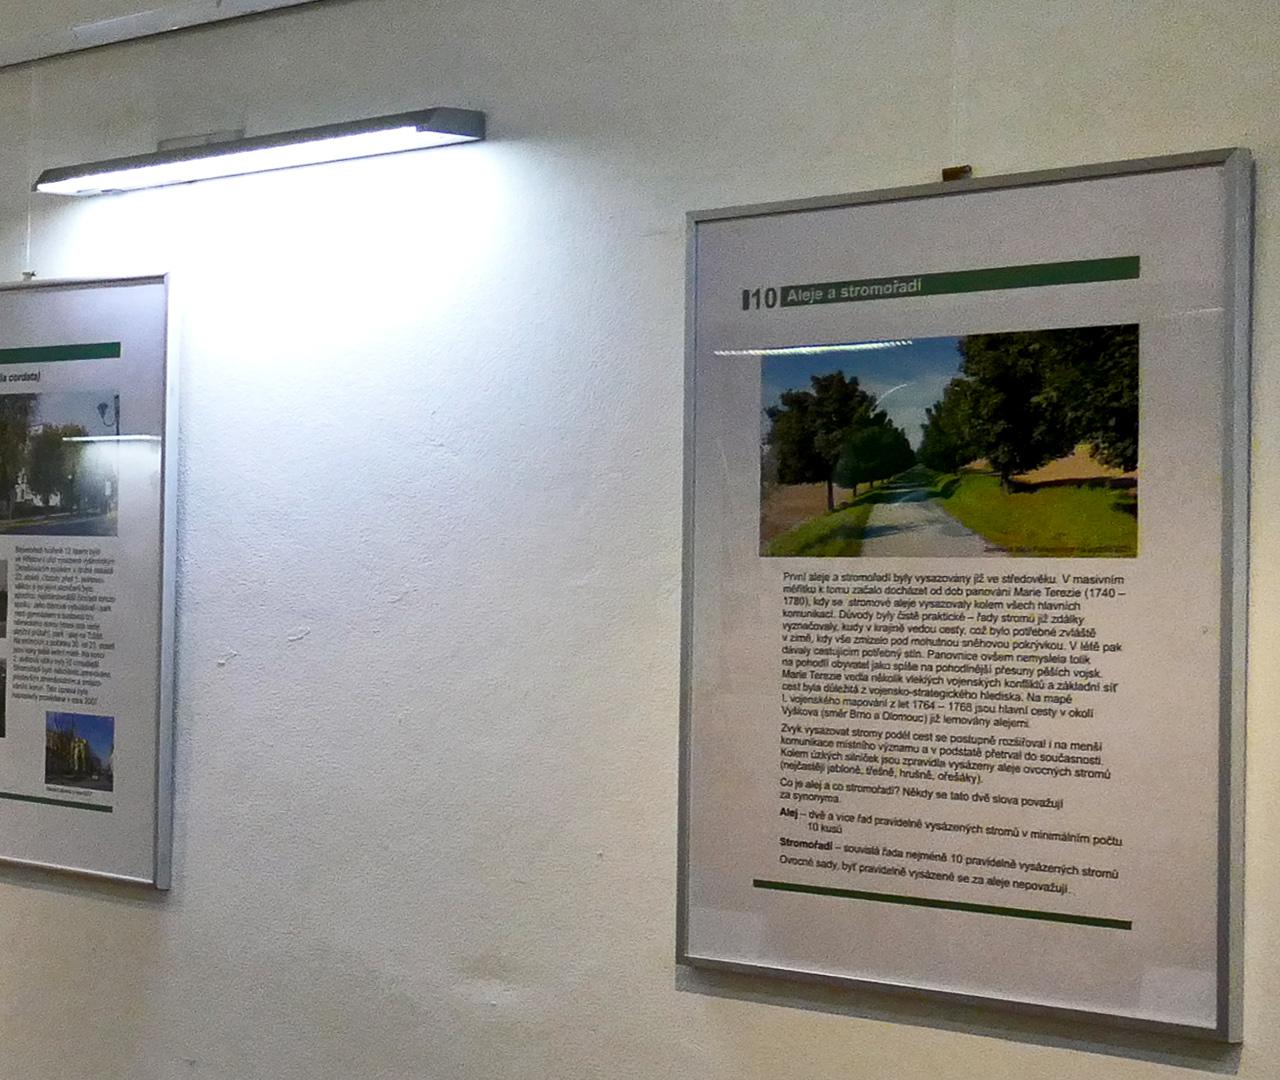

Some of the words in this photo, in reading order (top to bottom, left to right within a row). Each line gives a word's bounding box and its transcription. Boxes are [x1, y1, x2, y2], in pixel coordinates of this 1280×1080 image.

[786, 288, 824, 305] Aleje
[827, 288, 836, 299] a
[839, 278, 923, 299] stromořadí
